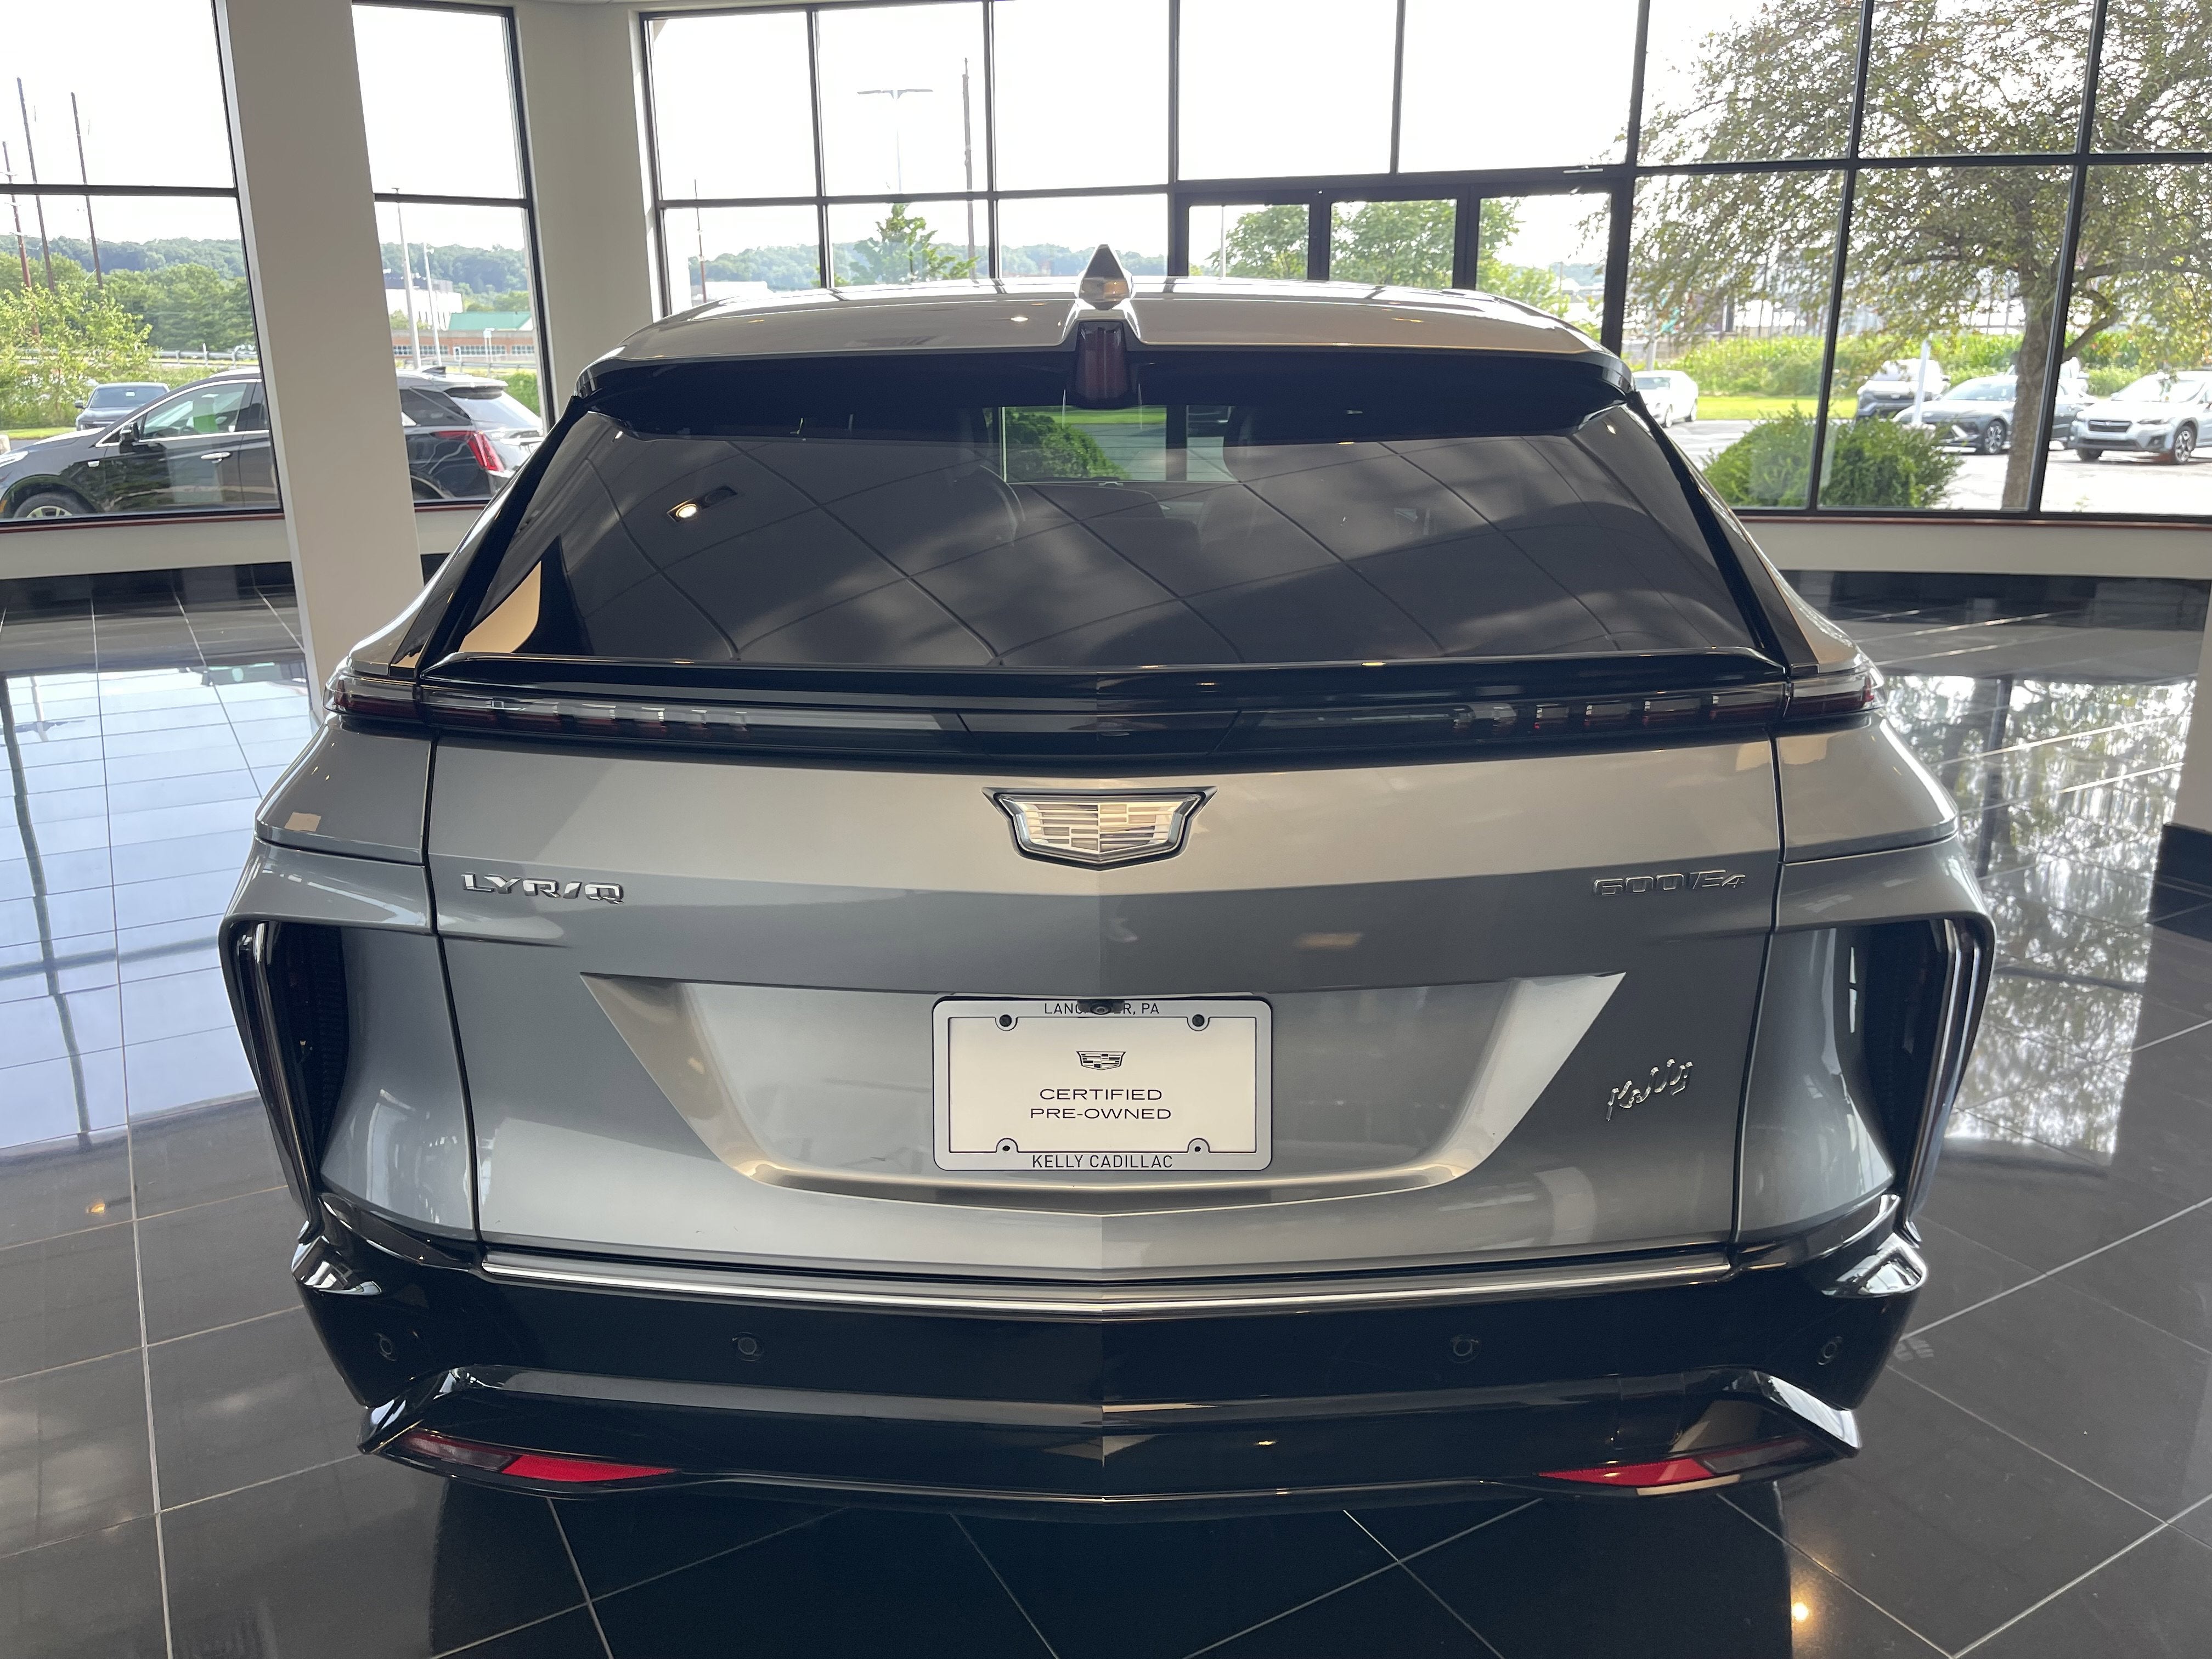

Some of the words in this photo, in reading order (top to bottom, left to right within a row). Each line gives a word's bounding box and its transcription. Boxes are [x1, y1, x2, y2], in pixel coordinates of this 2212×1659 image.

[461, 872, 624, 905] LYRIQ
[1142, 1003, 1159, 1014] PA
[1040, 1088, 1163, 1101] CERTIFIED
[1030, 1108, 1171, 1119] PRE-OWNED
[1032, 1155, 1084, 1168] KELLY
[1090, 1155, 1173, 1168] CADILLAC
